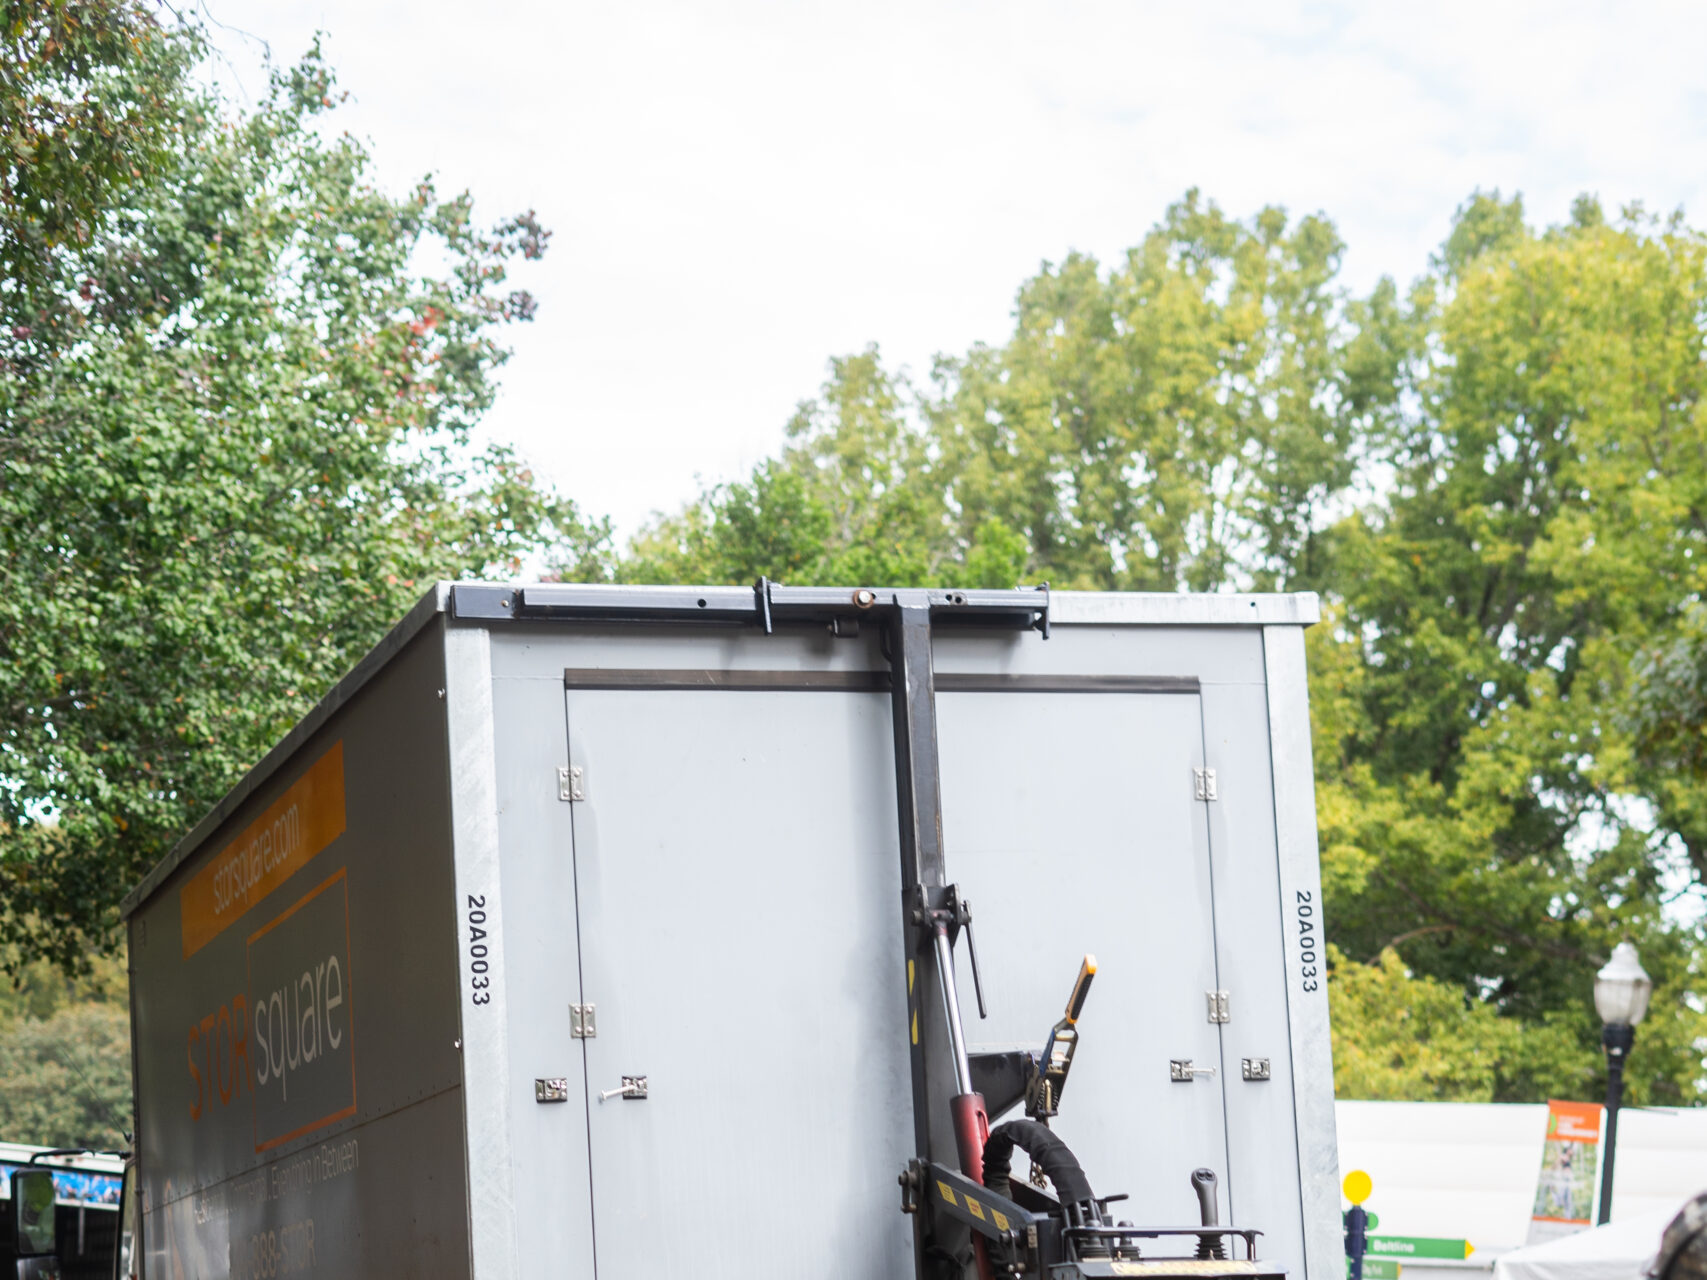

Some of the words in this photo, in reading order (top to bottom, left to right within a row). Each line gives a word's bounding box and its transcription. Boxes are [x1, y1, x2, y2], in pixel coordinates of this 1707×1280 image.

[213, 803, 300, 915] storsquare.com
[467, 894, 490, 1006] 20A0033
[1296, 890, 1318, 993] 20A0033
[255, 954, 343, 1102] square
[321, 1138, 359, 1181] Between
[1373, 1239, 1415, 1253] Beltline
